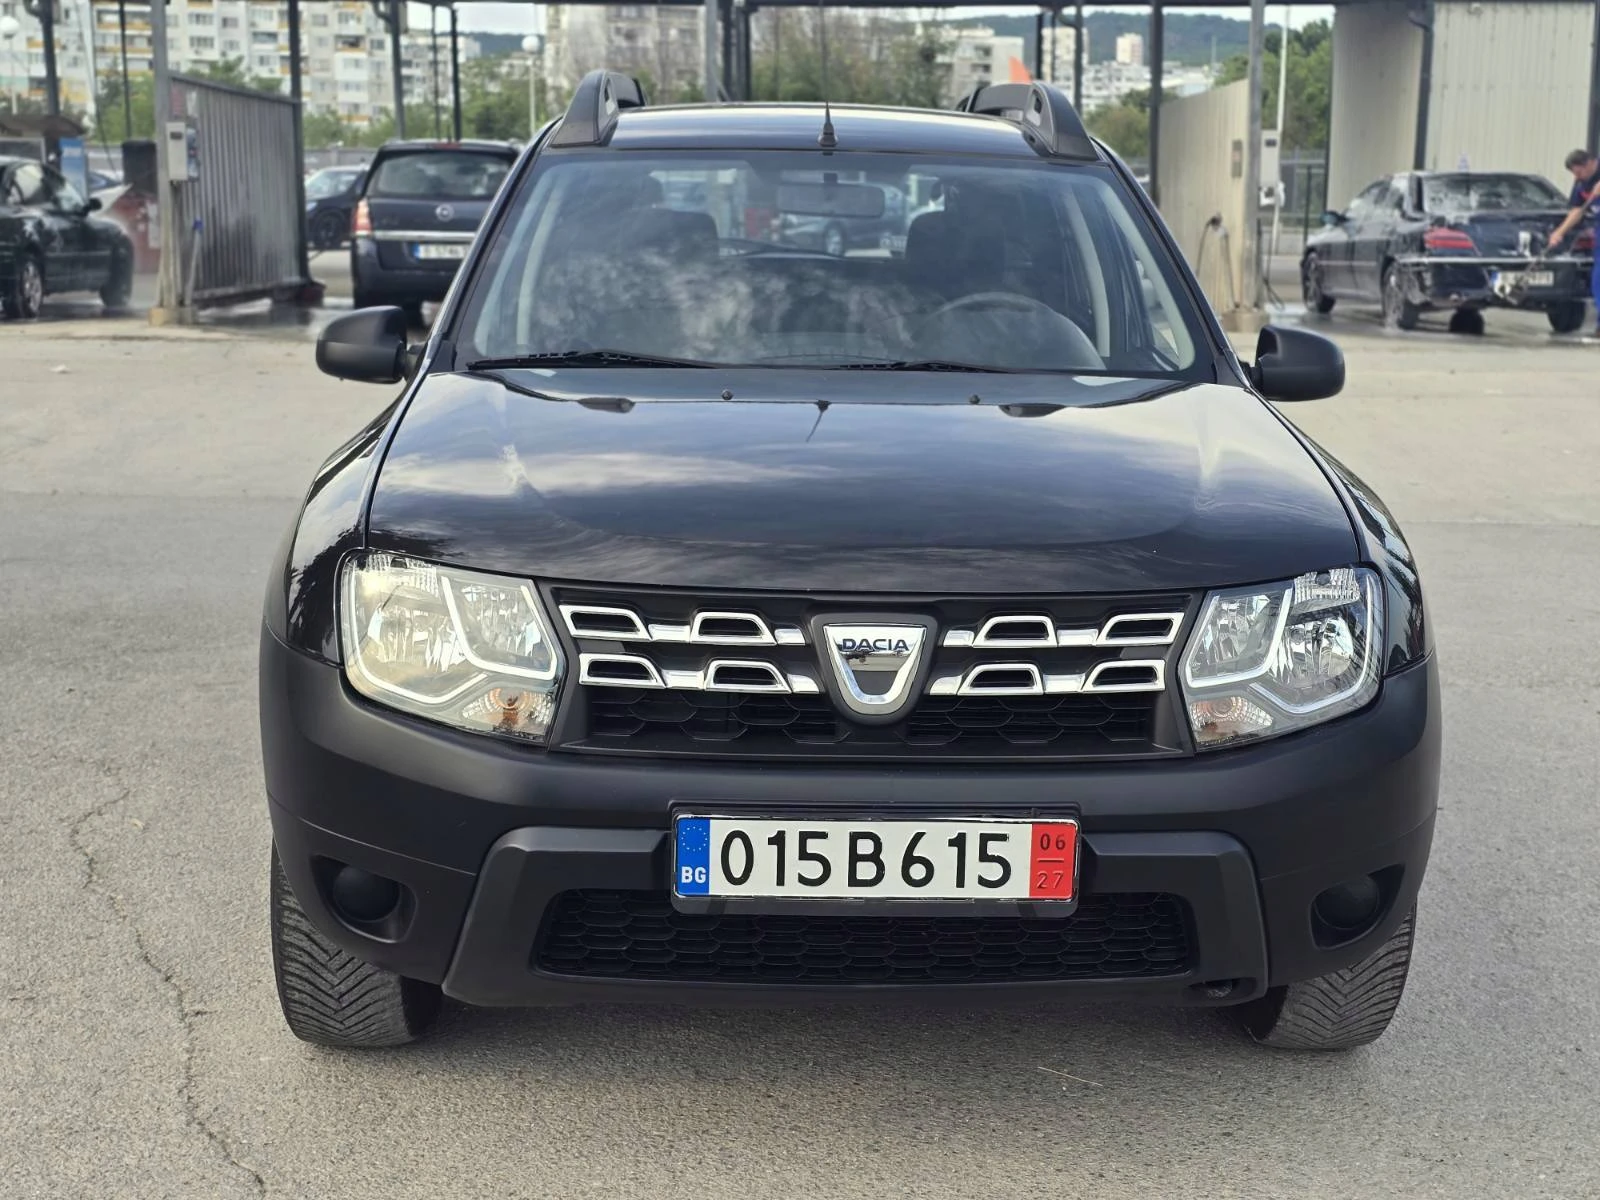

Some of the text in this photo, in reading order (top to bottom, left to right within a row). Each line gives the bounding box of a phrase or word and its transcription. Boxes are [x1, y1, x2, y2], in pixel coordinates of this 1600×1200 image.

[841, 638, 909, 652] DACIA
[1040, 832, 1066, 850] 06
[681, 867, 706, 884] BG
[1036, 870, 1064, 889] 27
